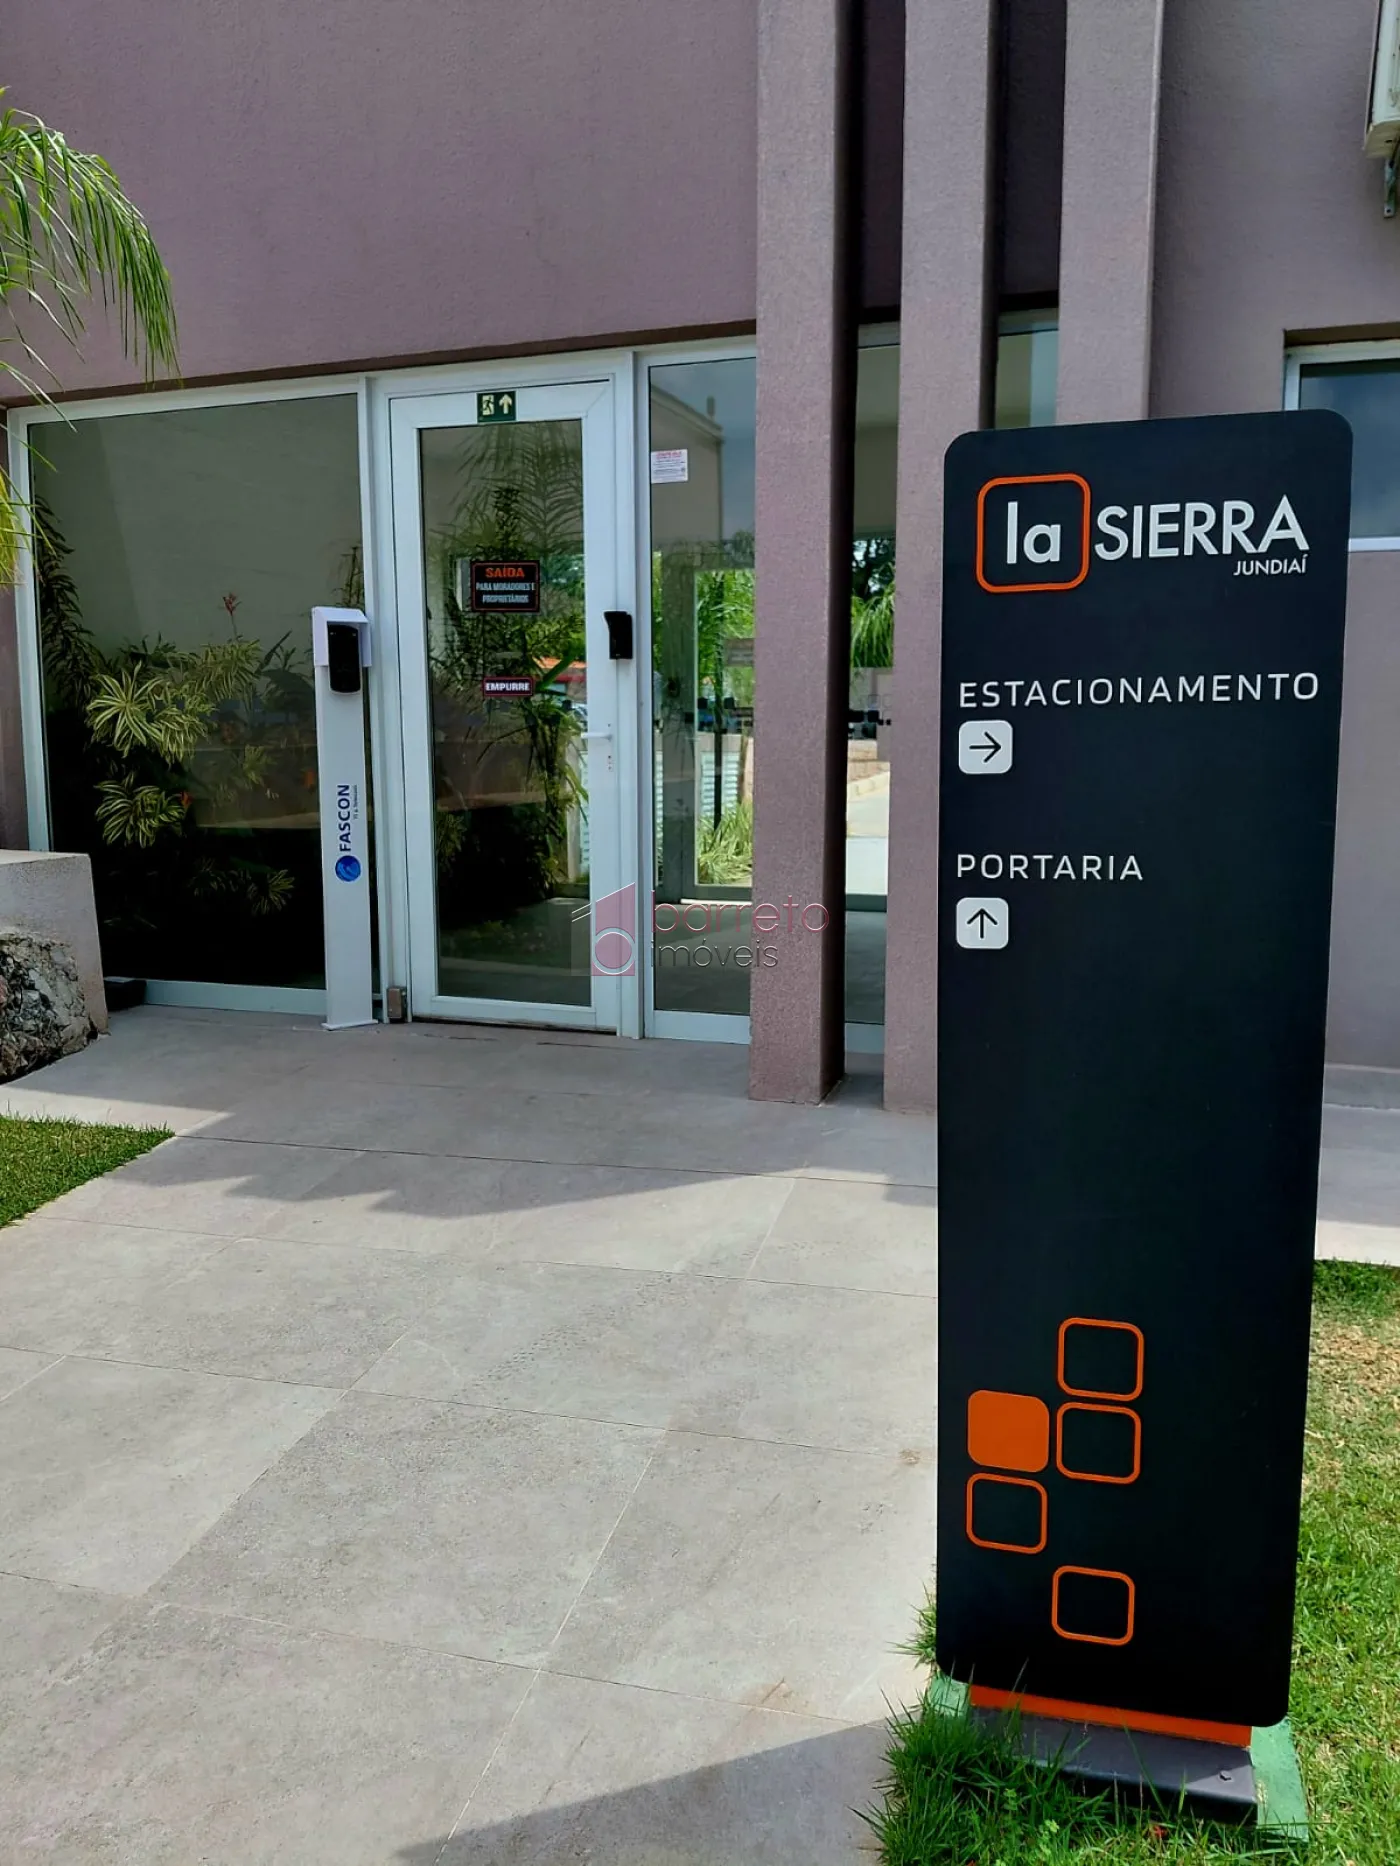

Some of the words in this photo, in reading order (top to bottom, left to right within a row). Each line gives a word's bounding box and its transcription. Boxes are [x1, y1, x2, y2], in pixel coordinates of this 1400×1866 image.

[1006, 501, 1062, 565] la
[1094, 494, 1310, 560] SIERRA
[485, 566, 525, 578] SAÍDA
[1233, 553, 1308, 576] JUNDIAÍ
[485, 682, 530, 691] EMPURRE
[959, 672, 1319, 708] ESTACIONAMENTO
[336, 784, 351, 852] FASCON
[957, 854, 1143, 880] PORTARIA
